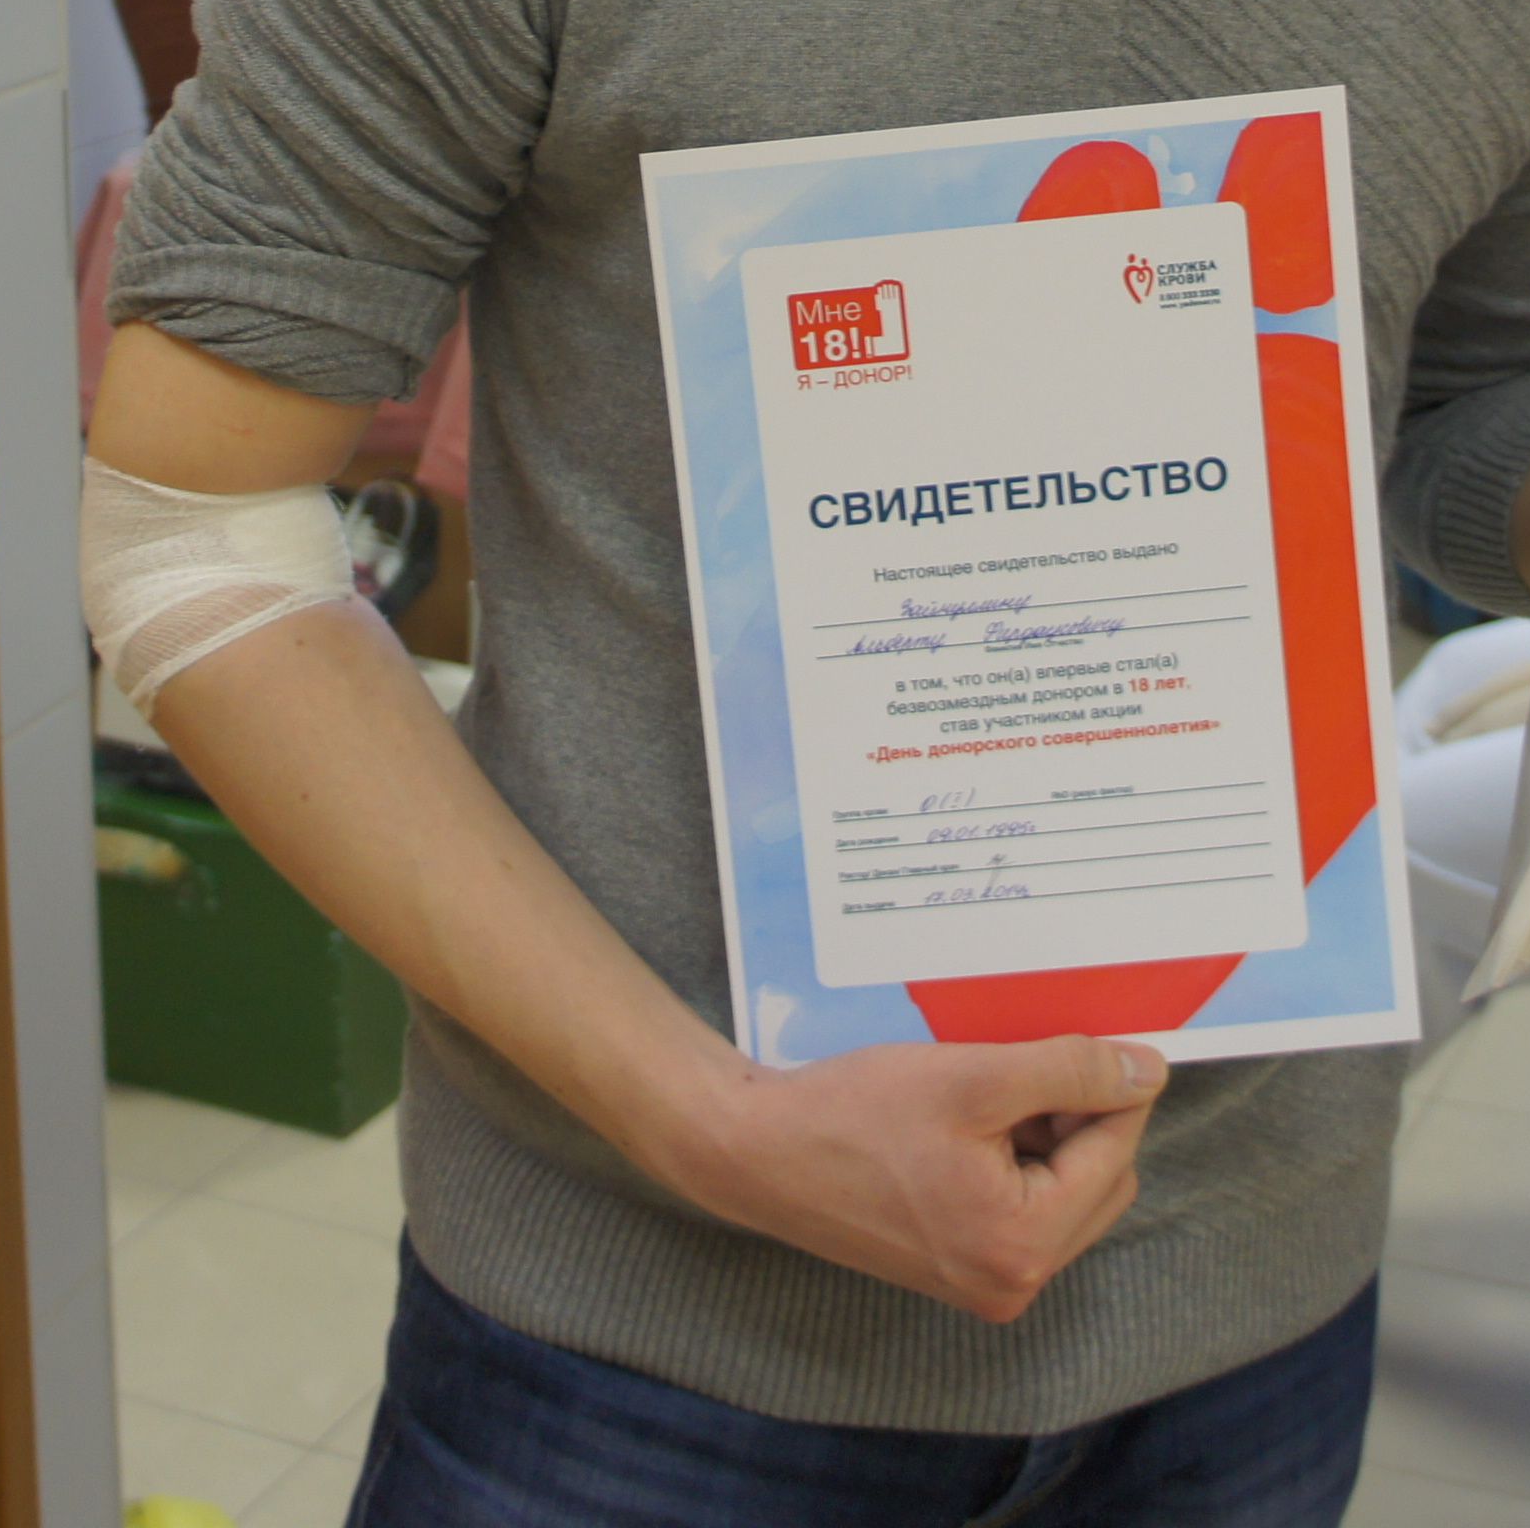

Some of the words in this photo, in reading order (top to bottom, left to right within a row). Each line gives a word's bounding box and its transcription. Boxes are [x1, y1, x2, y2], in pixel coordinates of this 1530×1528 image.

[1157, 260, 1217, 275] СЛУЖБА
[1158, 273, 1206, 287] КРОВИ
[796, 299, 862, 325] Мне
[800, 327, 862, 363] 18!
[797, 374, 812, 390] Я
[834, 365, 914, 390] ДОНОР!
[809, 456, 1228, 529] СВИДЕТЕЛЬСТВО
[873, 563, 973, 583] Настоящее
[977, 549, 1108, 574] свидетельство
[1112, 541, 1179, 562] выдано
[895, 680, 906, 693] в
[910, 676, 949, 691] том,
[952, 673, 983, 687] что
[986, 665, 1031, 685] он(а)
[1035, 659, 1112, 680] впервые
[1115, 652, 1179, 673] стал(а)
[886, 691, 1027, 716] безвозмездным
[1031, 682, 1109, 704] донором
[1113, 682, 1124, 695] в
[1128, 677, 1150, 693] 18
[939, 718, 980, 733] став
[982, 710, 1086, 733] участником
[1090, 703, 1143, 721] акции
[927, 735, 1038, 759] донорского
[1041, 719, 1221, 747] совершеннолетия»
